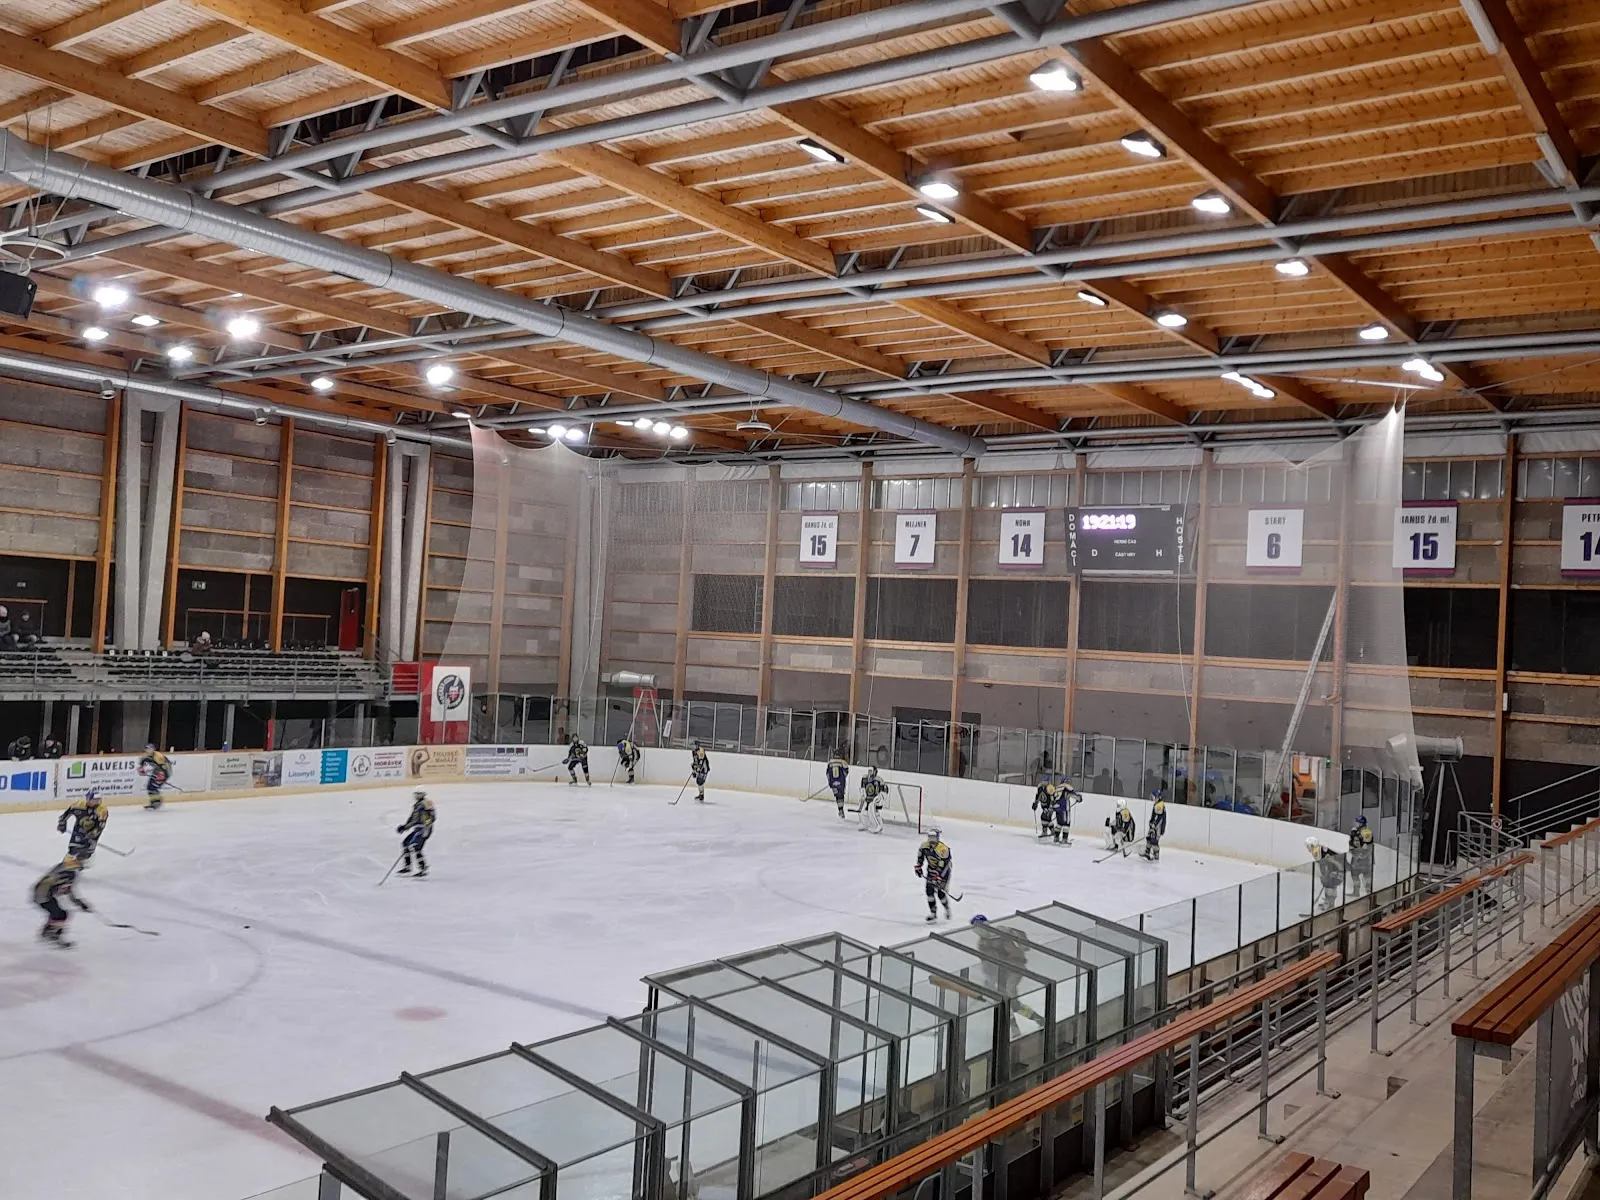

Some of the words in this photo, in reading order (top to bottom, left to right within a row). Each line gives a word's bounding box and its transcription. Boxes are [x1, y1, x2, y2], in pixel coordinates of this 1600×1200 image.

[810, 534, 827, 556] 15
[910, 535, 920, 556] 7
[1011, 534, 1032, 557] 14
[1091, 549, 1098, 557] D
[1156, 549, 1163, 557] H
[1267, 533, 1281, 559] 6
[1409, 532, 1439, 560] 15
[91, 761, 135, 771] ALVELIS
